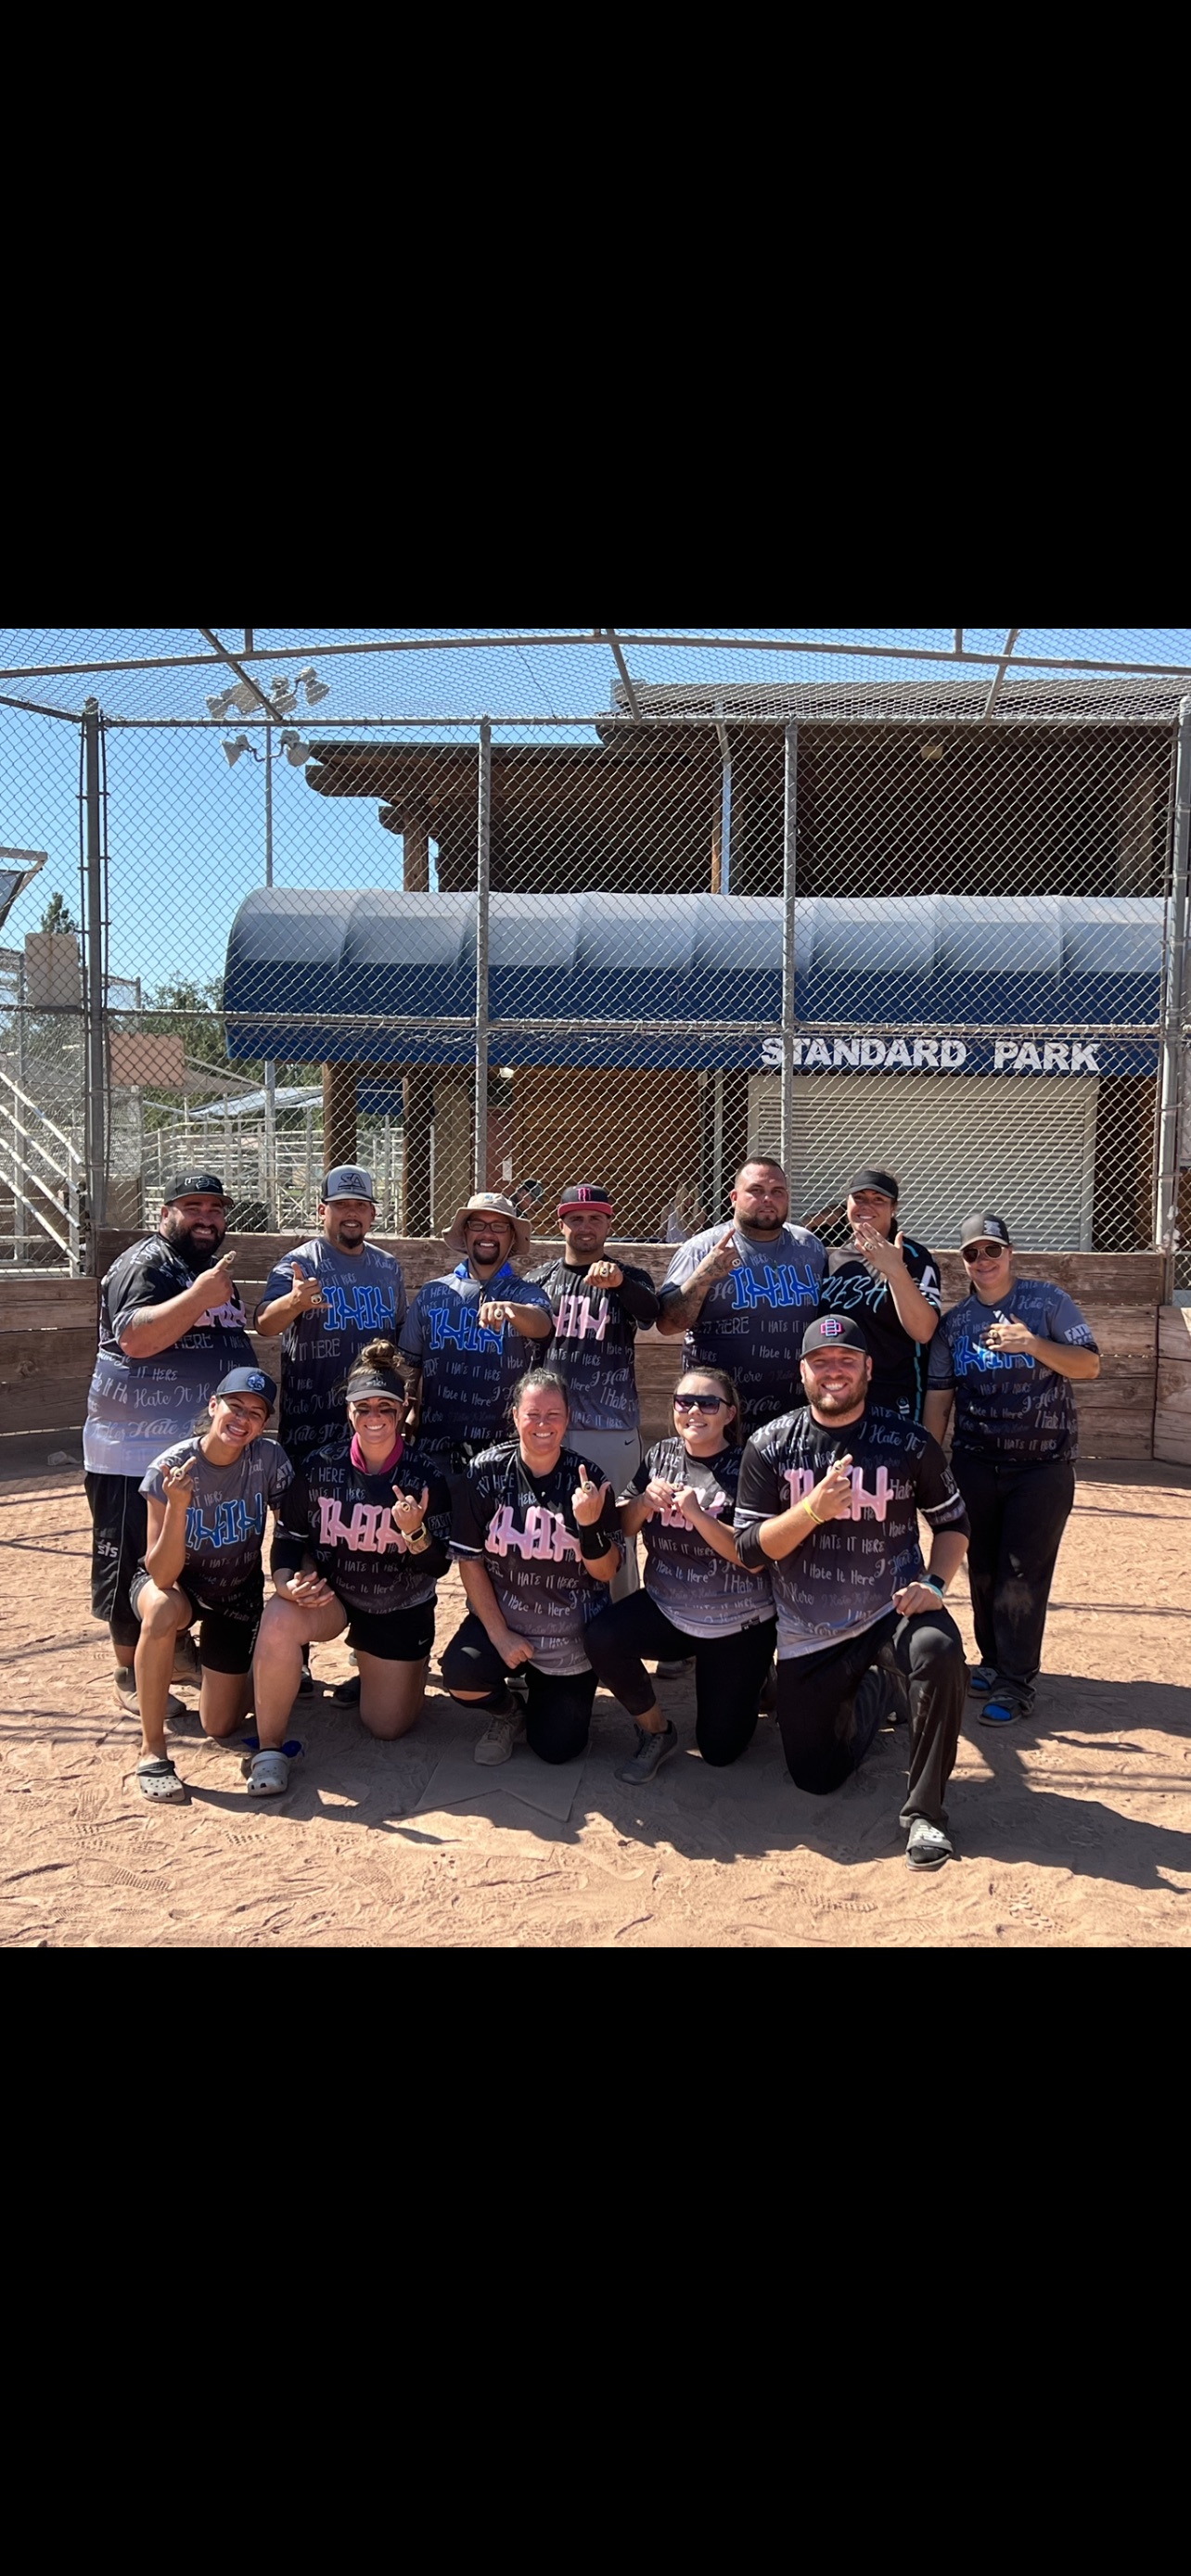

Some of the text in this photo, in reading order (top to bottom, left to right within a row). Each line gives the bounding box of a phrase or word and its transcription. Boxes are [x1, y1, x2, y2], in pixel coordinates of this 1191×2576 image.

[761, 1037, 1101, 1072] STANDARD PARK
[728, 1264, 819, 1310] IHIH
[768, 1320, 788, 1333] HATE
[311, 1338, 341, 1359] HERE
[869, 1423, 903, 1447] Hate
[318, 1467, 346, 1484] HERE
[518, 1492, 537, 1507] HERE
[820, 1535, 842, 1551] HATE
[847, 1537, 857, 1552] IT
[862, 1538, 885, 1553] HERE
[518, 1572, 541, 1587] HATE
[545, 1575, 555, 1589] IT
[557, 1576, 580, 1589] HERE
[687, 1569, 709, 1584] Here
[809, 1562, 833, 1580] Hate
[837, 1568, 846, 1583] It
[851, 1569, 876, 1587] Here
[508, 1594, 529, 1613] Hate
[547, 1603, 570, 1616] Here
